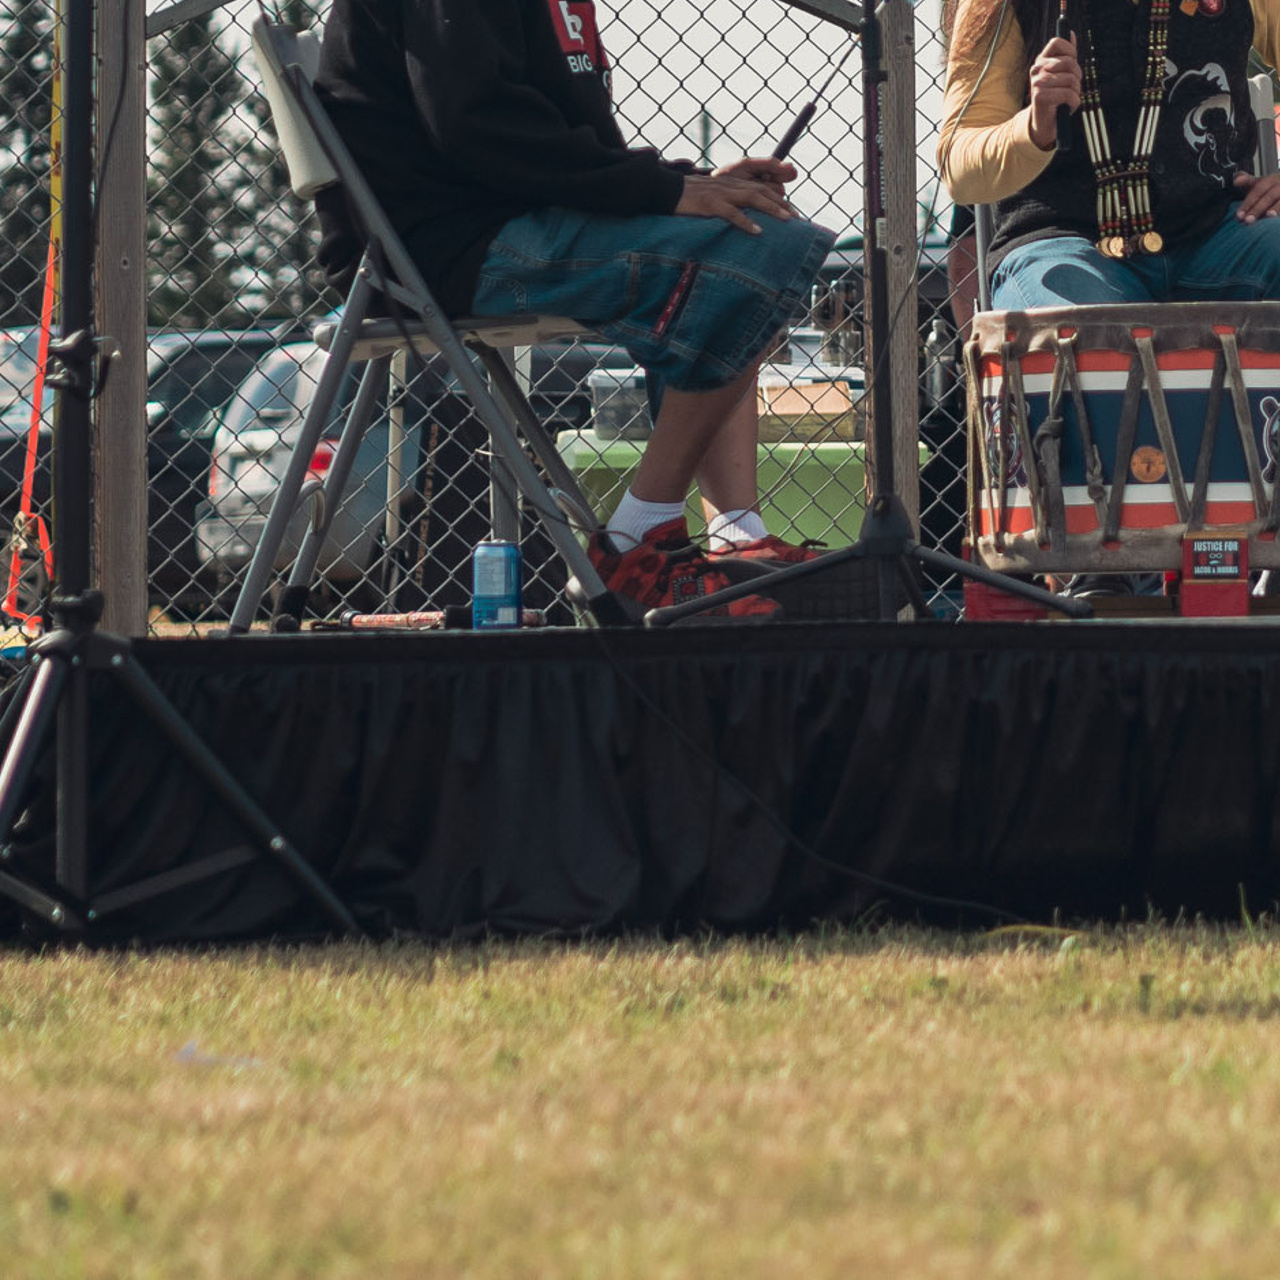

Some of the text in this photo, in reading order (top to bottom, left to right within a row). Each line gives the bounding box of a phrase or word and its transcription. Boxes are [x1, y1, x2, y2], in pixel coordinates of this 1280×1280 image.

[567, 54, 593, 73] BIG
[1193, 541, 1239, 552] JUSTICE FOR
